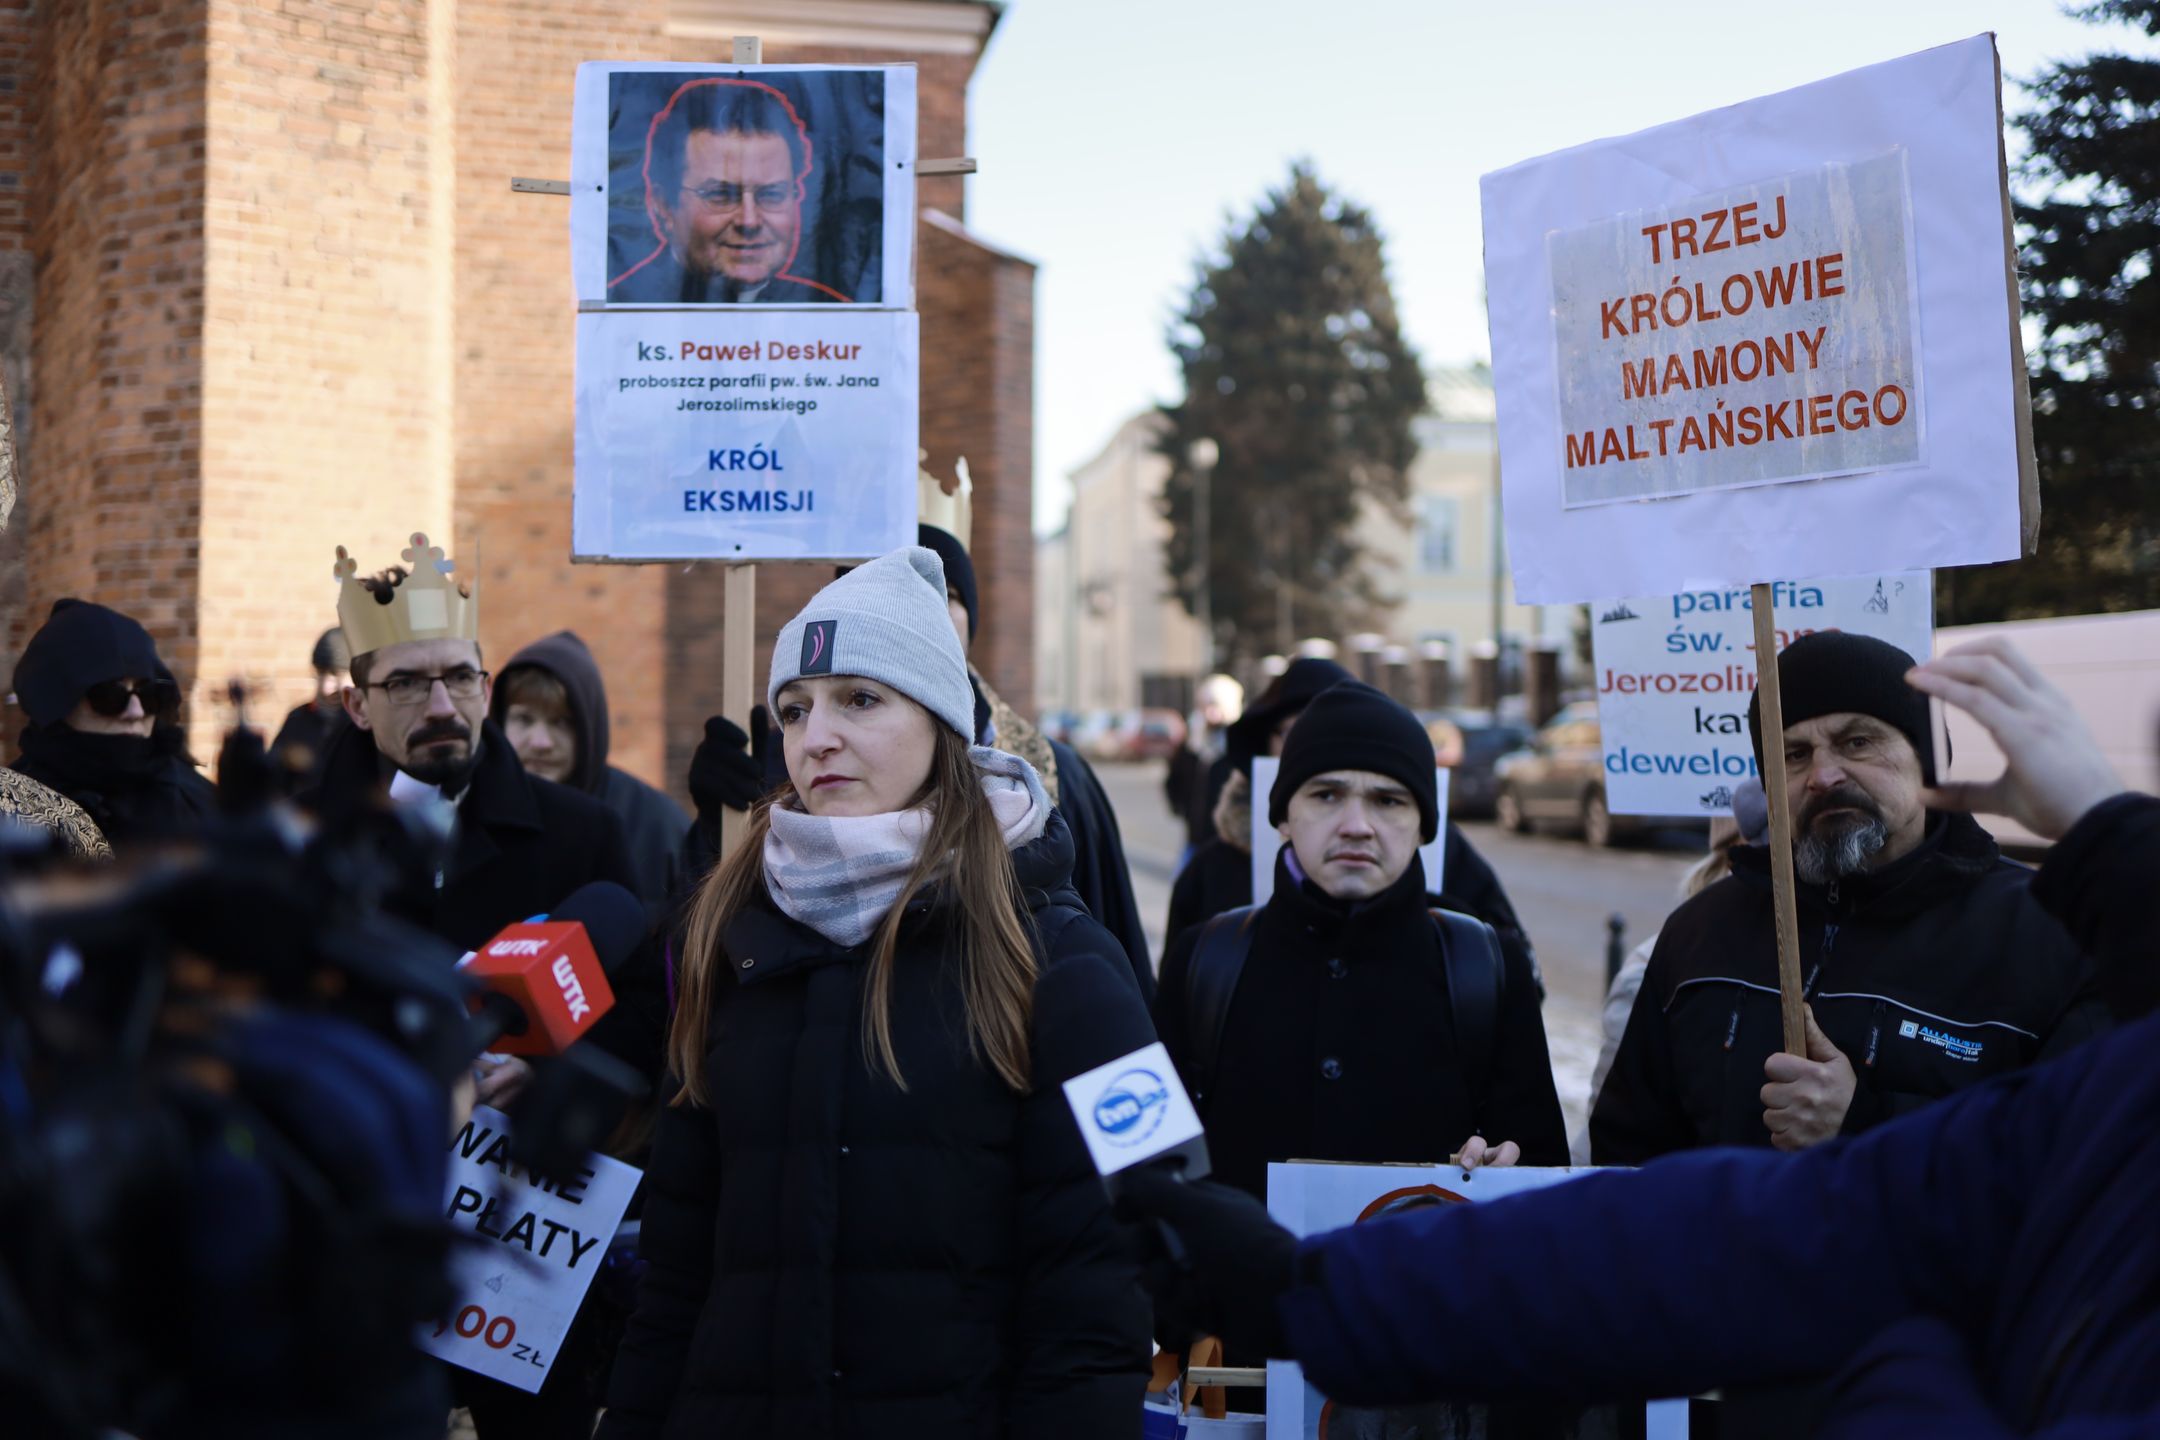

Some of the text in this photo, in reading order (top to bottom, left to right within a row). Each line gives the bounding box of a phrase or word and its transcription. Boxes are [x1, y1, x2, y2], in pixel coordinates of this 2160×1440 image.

[1641, 195, 1787, 264] TRZEJ
[1601, 252, 1846, 340] KRÓLOWIE
[638, 340, 862, 361] ks. Paweł Deskur
[1621, 326, 1827, 400] MAMONY
[619, 373, 880, 392] proboszcz parafii pw. św. Jana
[676, 398, 818, 415] Jerozolimskiego
[1566, 383, 1908, 469] MALTAŃSKIEGO
[708, 442, 784, 471] KRÓL
[683, 489, 813, 512] EKSMISJI
[1666, 624, 1733, 654] św.
[1600, 664, 1757, 694] Jerozoli
[1605, 746, 1757, 780] dewelo
